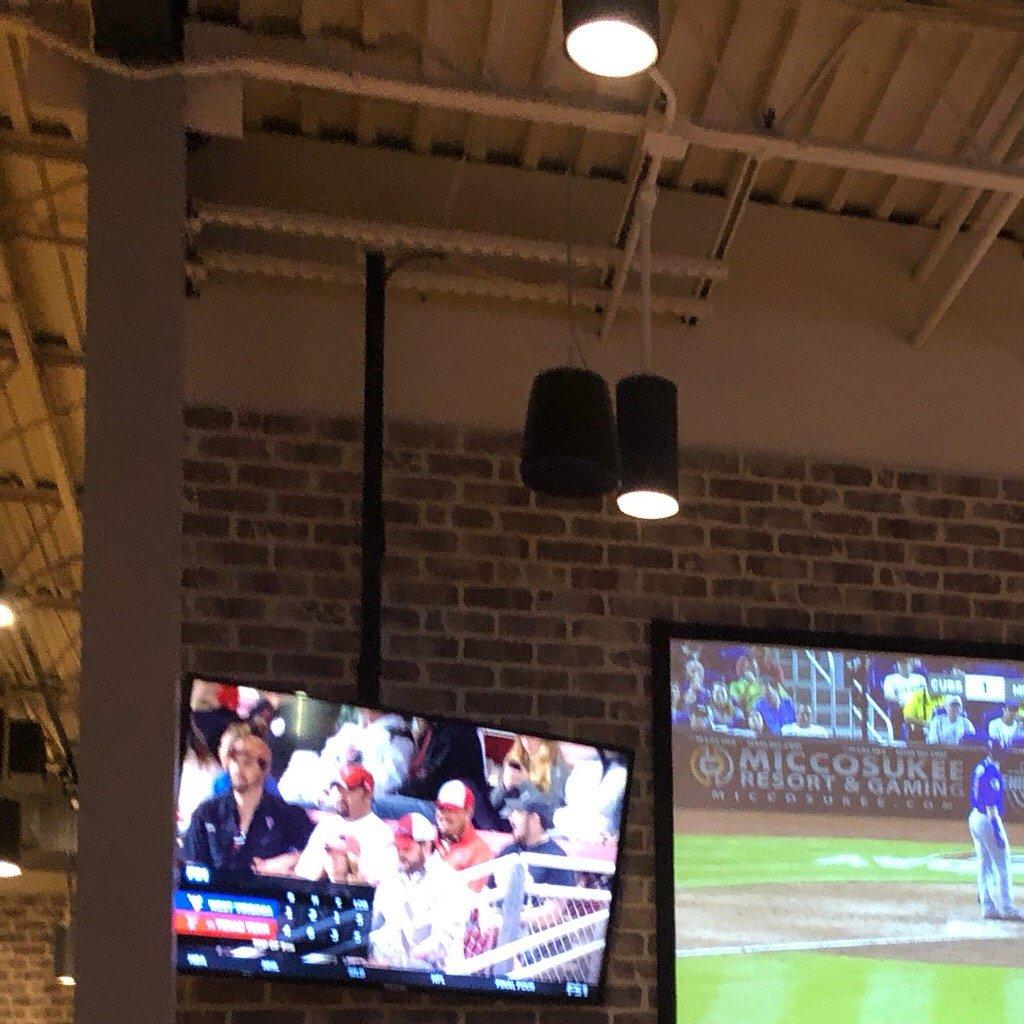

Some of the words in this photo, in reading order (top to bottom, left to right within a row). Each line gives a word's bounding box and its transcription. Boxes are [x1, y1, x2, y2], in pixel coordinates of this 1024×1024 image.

[739, 749, 965, 781] MICCOSUKEE
[740, 769, 834, 792] RESORT
[844, 775, 860, 793] &
[866, 777, 966, 797] GAMING
